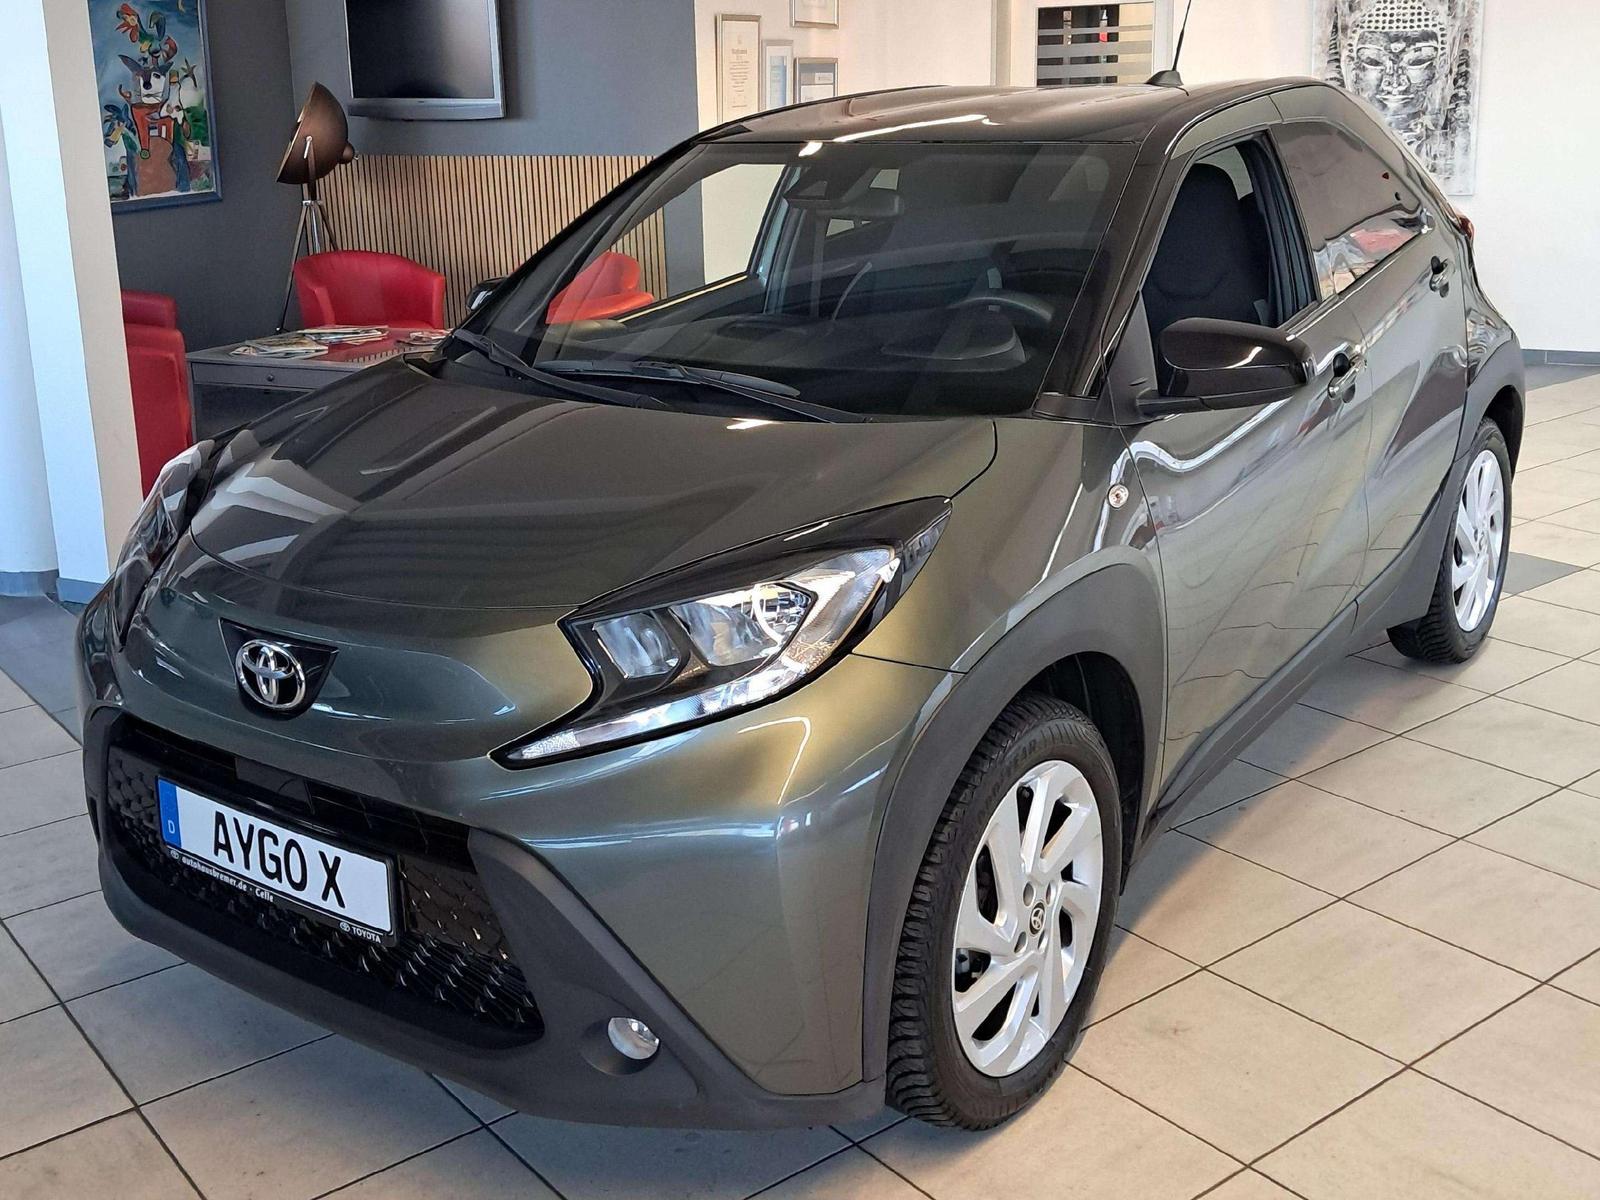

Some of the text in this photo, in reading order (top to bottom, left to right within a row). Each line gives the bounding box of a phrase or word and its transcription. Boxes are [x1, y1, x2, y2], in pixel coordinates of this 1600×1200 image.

[168, 819, 176, 834] D
[213, 810, 346, 909] AYGO X
[181, 855, 274, 903] autohausbremer.de Celle
[351, 926, 382, 944] TOYOTA
